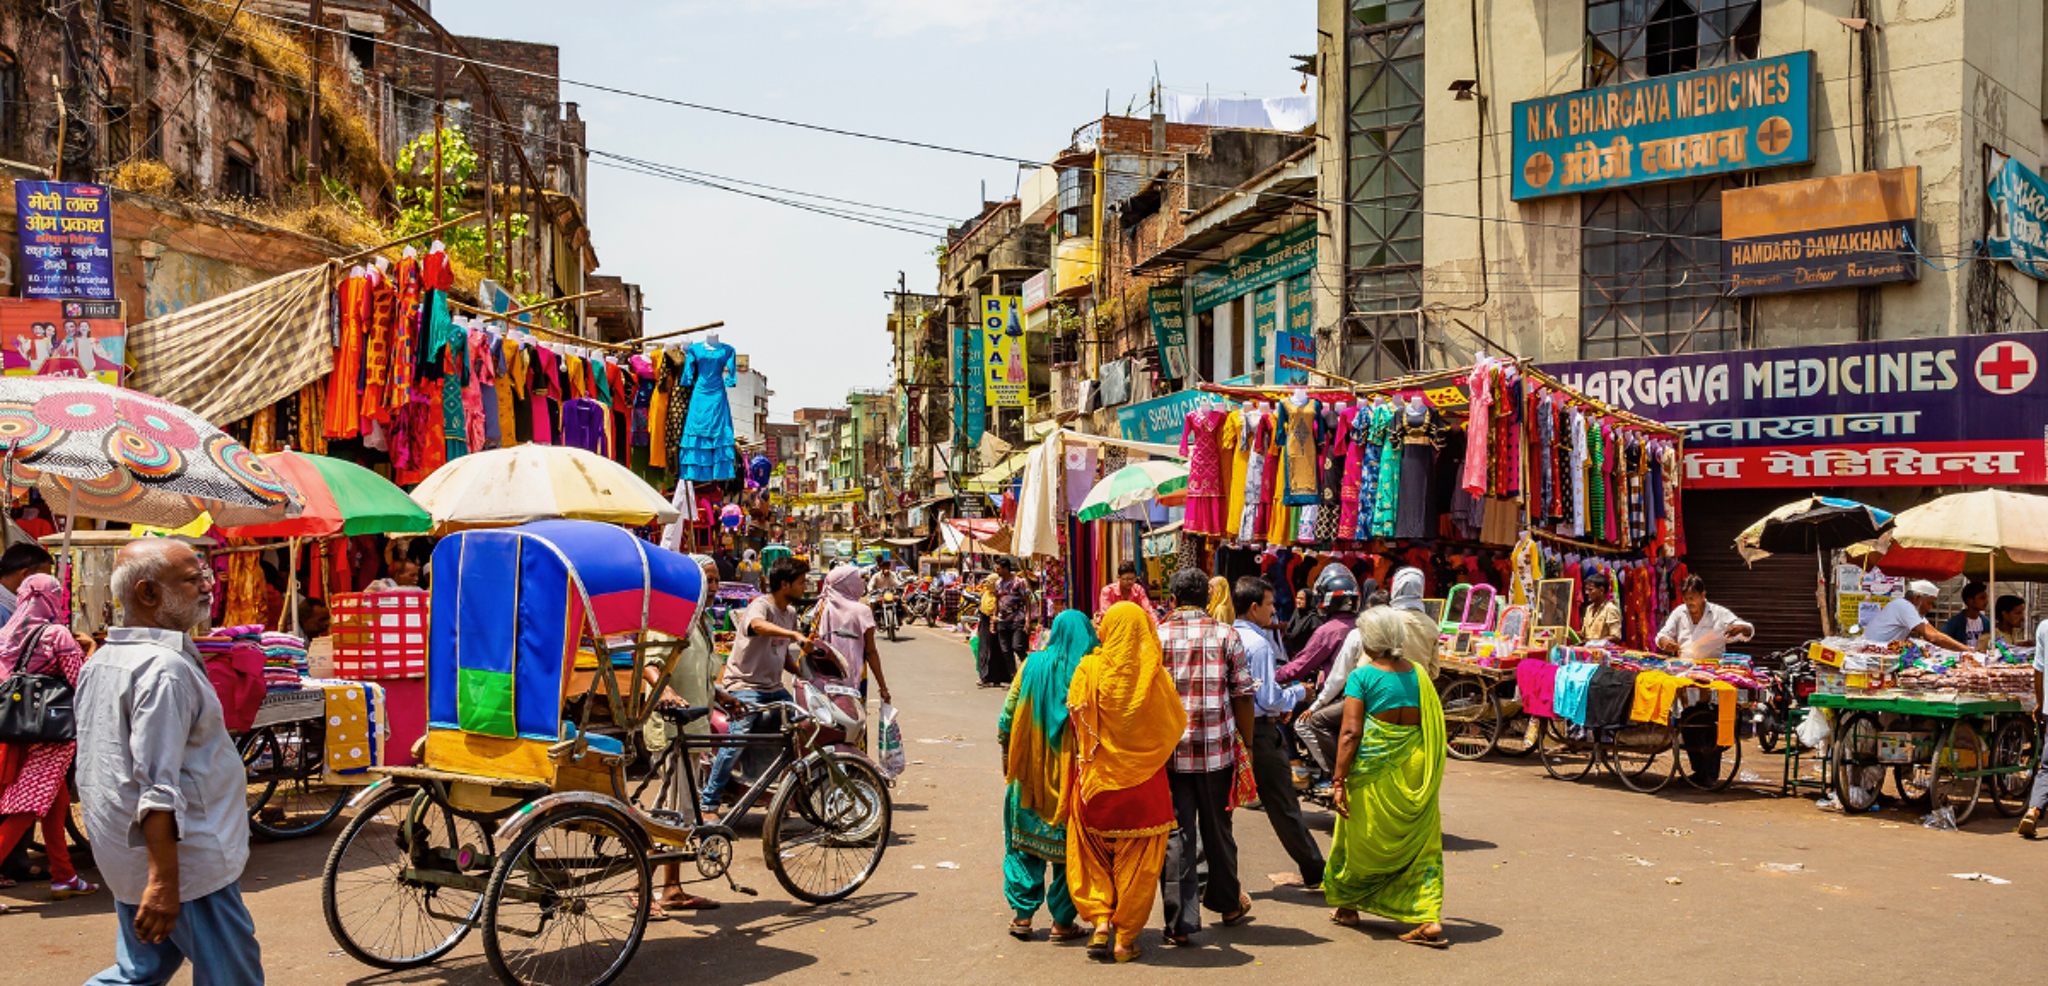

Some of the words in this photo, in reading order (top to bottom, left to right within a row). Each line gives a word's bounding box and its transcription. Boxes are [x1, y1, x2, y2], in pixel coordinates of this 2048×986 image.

[1526, 101, 1564, 143] N.K.
[1568, 83, 1672, 137] BHARGAVA
[1676, 62, 1790, 119] MEDICINES
[1560, 135, 1634, 186] अंग्रेजी
[1638, 126, 1749, 174] दवाखाना
[27, 190, 62, 211] मोती
[64, 197, 99, 213] लाल
[25, 211, 58, 231] ओम
[60, 217, 105, 234] प्रकाश
[1731, 239, 1802, 267] HAMDARD
[1805, 228, 1906, 259] DAWAKHANA
[1792, 266, 1839, 285] Dabur
[986, 299, 1005, 383] ROYAL
[1289, 336, 1315, 354] TAJ
[1550, 363, 1730, 411] HARGAVA
[1743, 349, 1959, 400] MEDICINES
[1761, 447, 2025, 477] मेडिसिन्स
